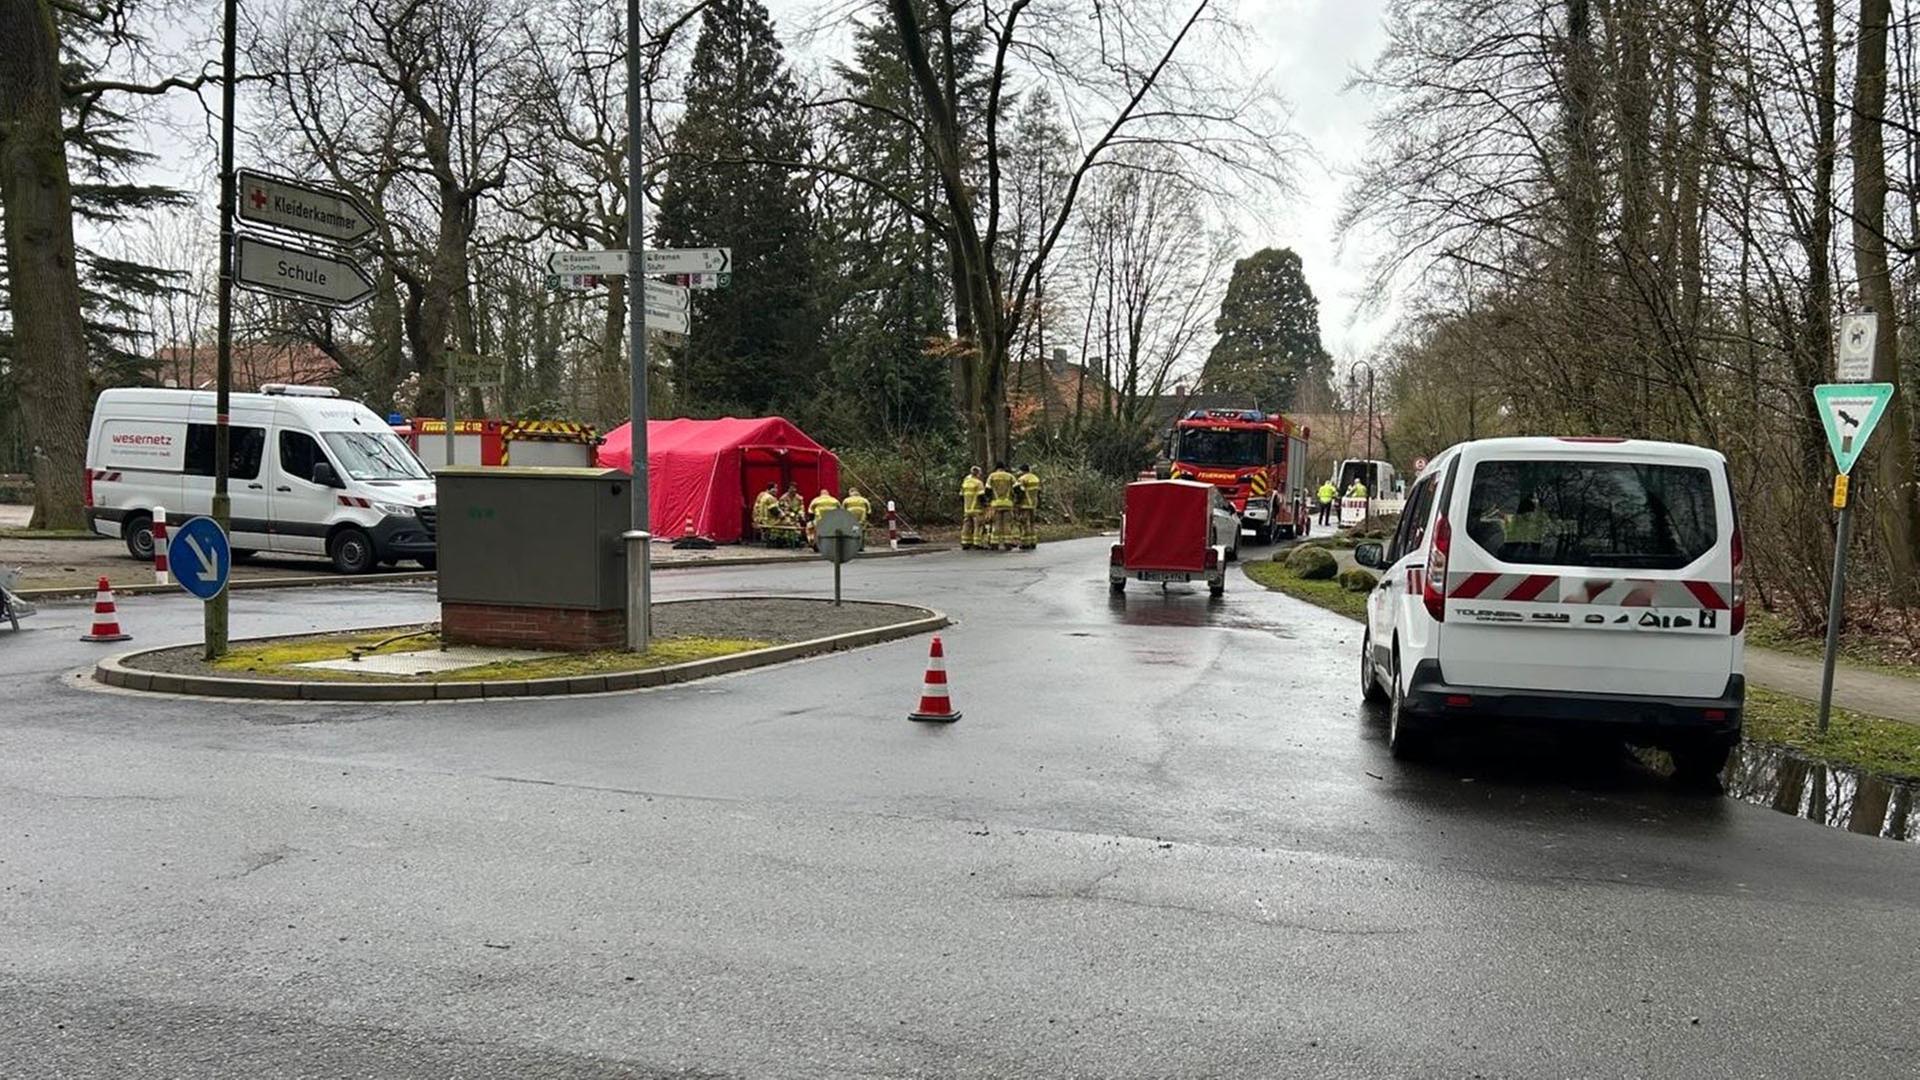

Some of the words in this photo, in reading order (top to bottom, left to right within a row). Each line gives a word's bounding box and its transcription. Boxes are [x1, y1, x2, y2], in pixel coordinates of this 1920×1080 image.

[274, 195, 356, 230] Kleiderkammer
[278, 261, 327, 285] Schule
[112, 434, 172, 445] wesernetz
